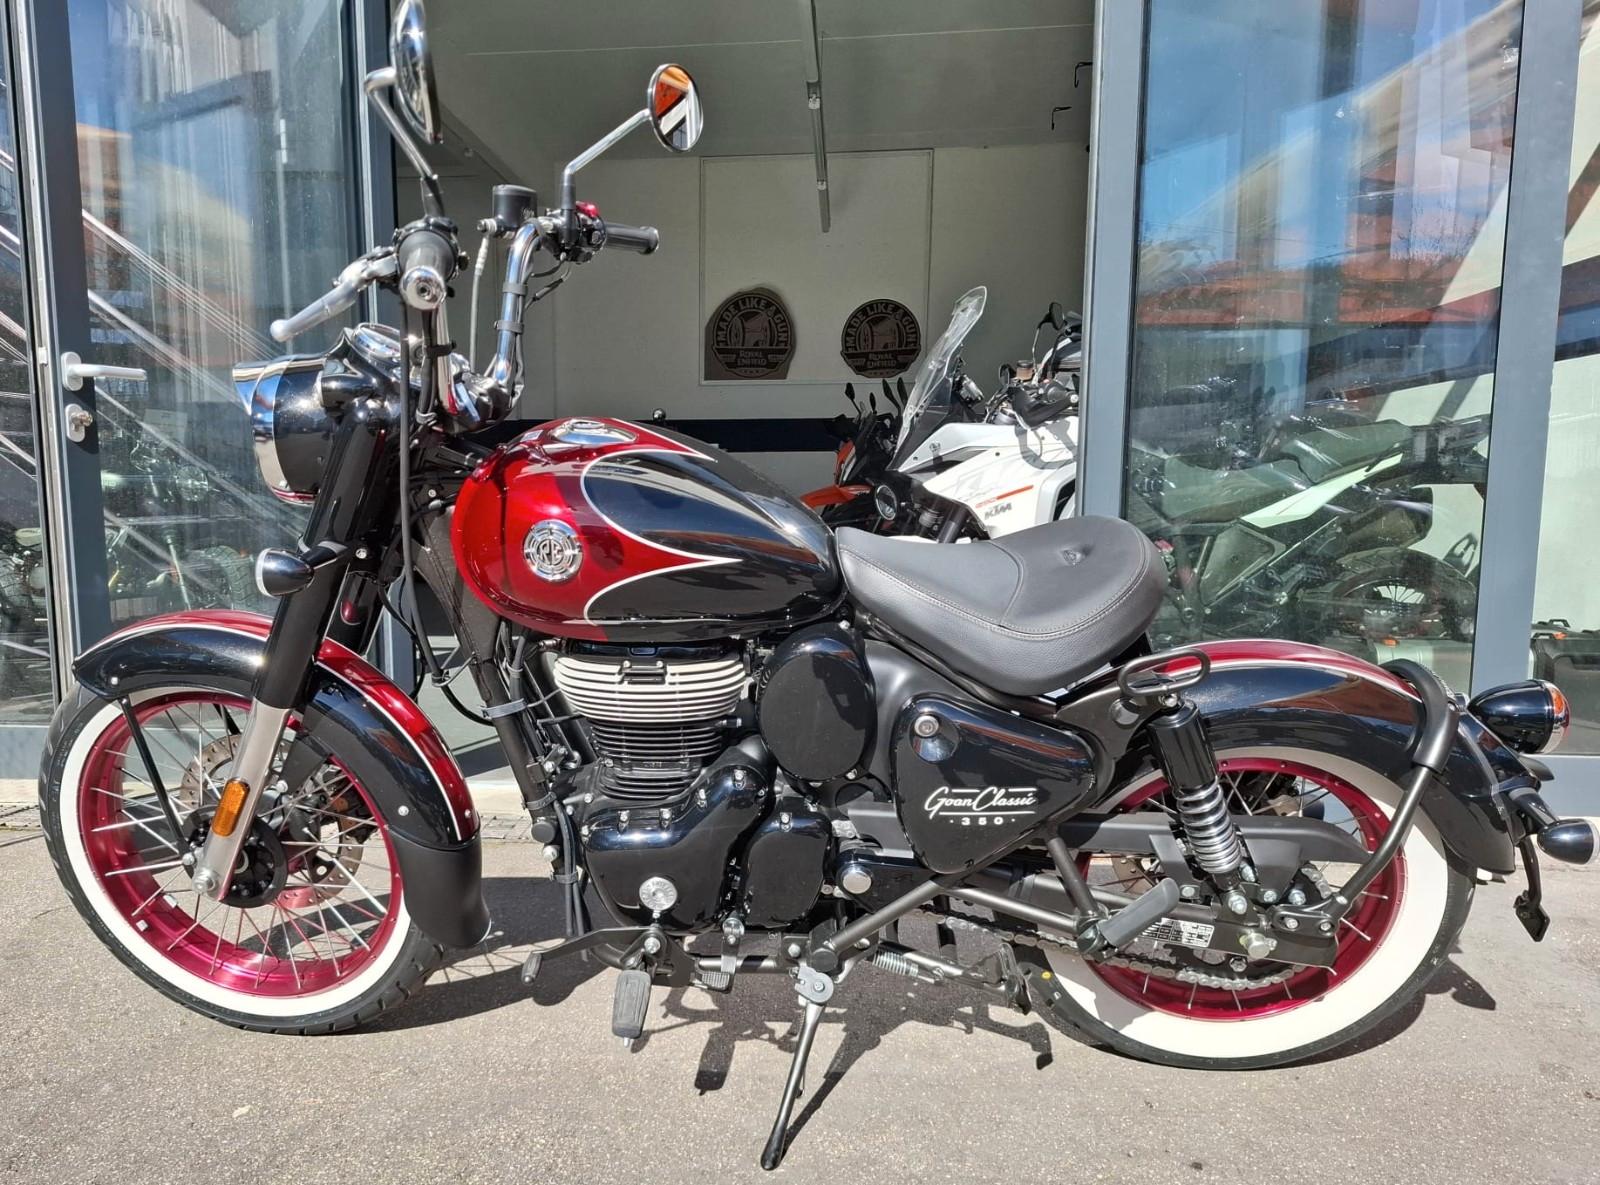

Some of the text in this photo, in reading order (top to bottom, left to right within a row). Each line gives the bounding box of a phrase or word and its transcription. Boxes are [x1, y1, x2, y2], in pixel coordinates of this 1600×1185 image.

[716, 304, 738, 342] MADE
[738, 296, 767, 311] LIKE
[774, 314, 788, 341] GUN
[845, 312, 866, 347] MADE
[866, 303, 895, 315] LIKE
[902, 316, 917, 344] GUN
[984, 502, 1012, 520] KTM
